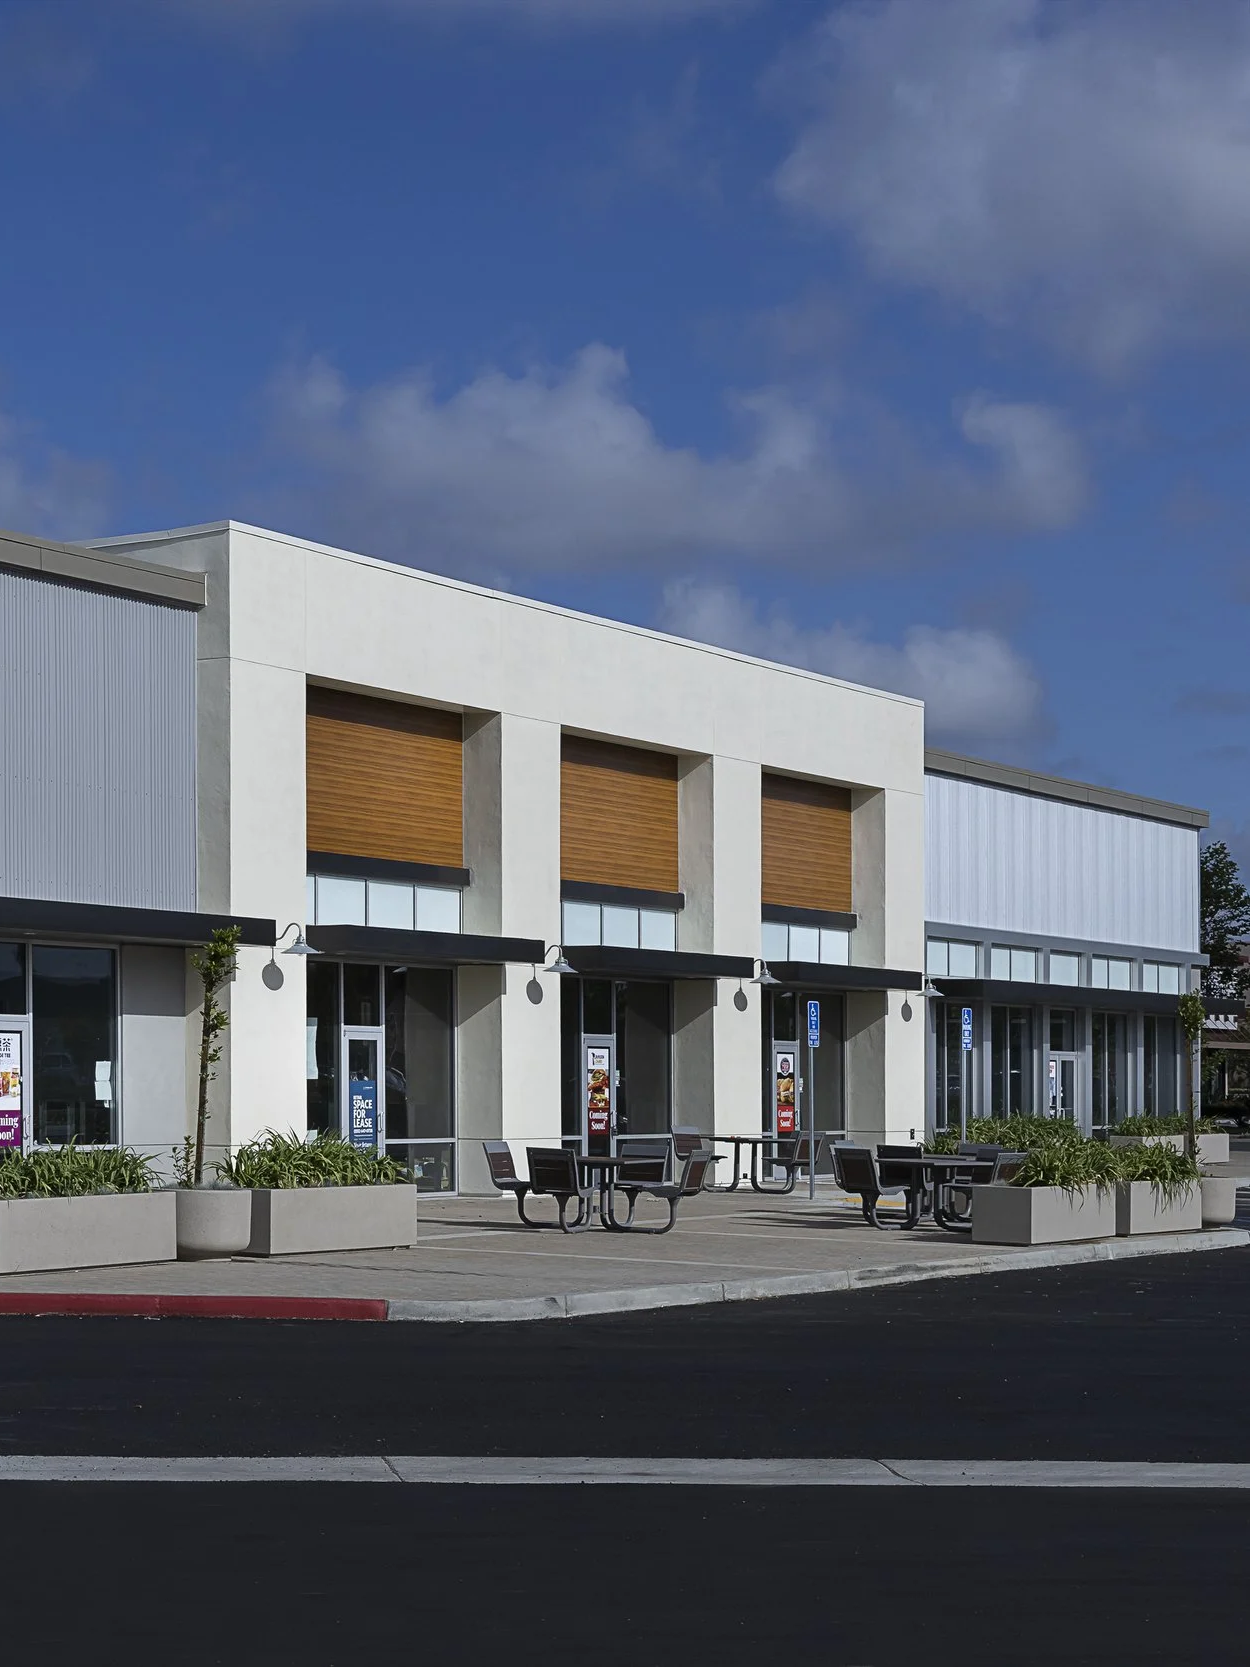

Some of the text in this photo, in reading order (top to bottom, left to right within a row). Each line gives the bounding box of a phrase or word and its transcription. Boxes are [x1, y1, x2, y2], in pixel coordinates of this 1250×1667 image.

[353, 1100, 372, 1109] SPACE
[353, 1109, 366, 1118] FOR
[589, 1110, 608, 1121] Coming
[778, 1109, 793, 1119] Coming
[354, 1118, 372, 1127] LEASE
[591, 1121, 605, 1130] Soon!
[780, 1119, 791, 1127] Soon!
